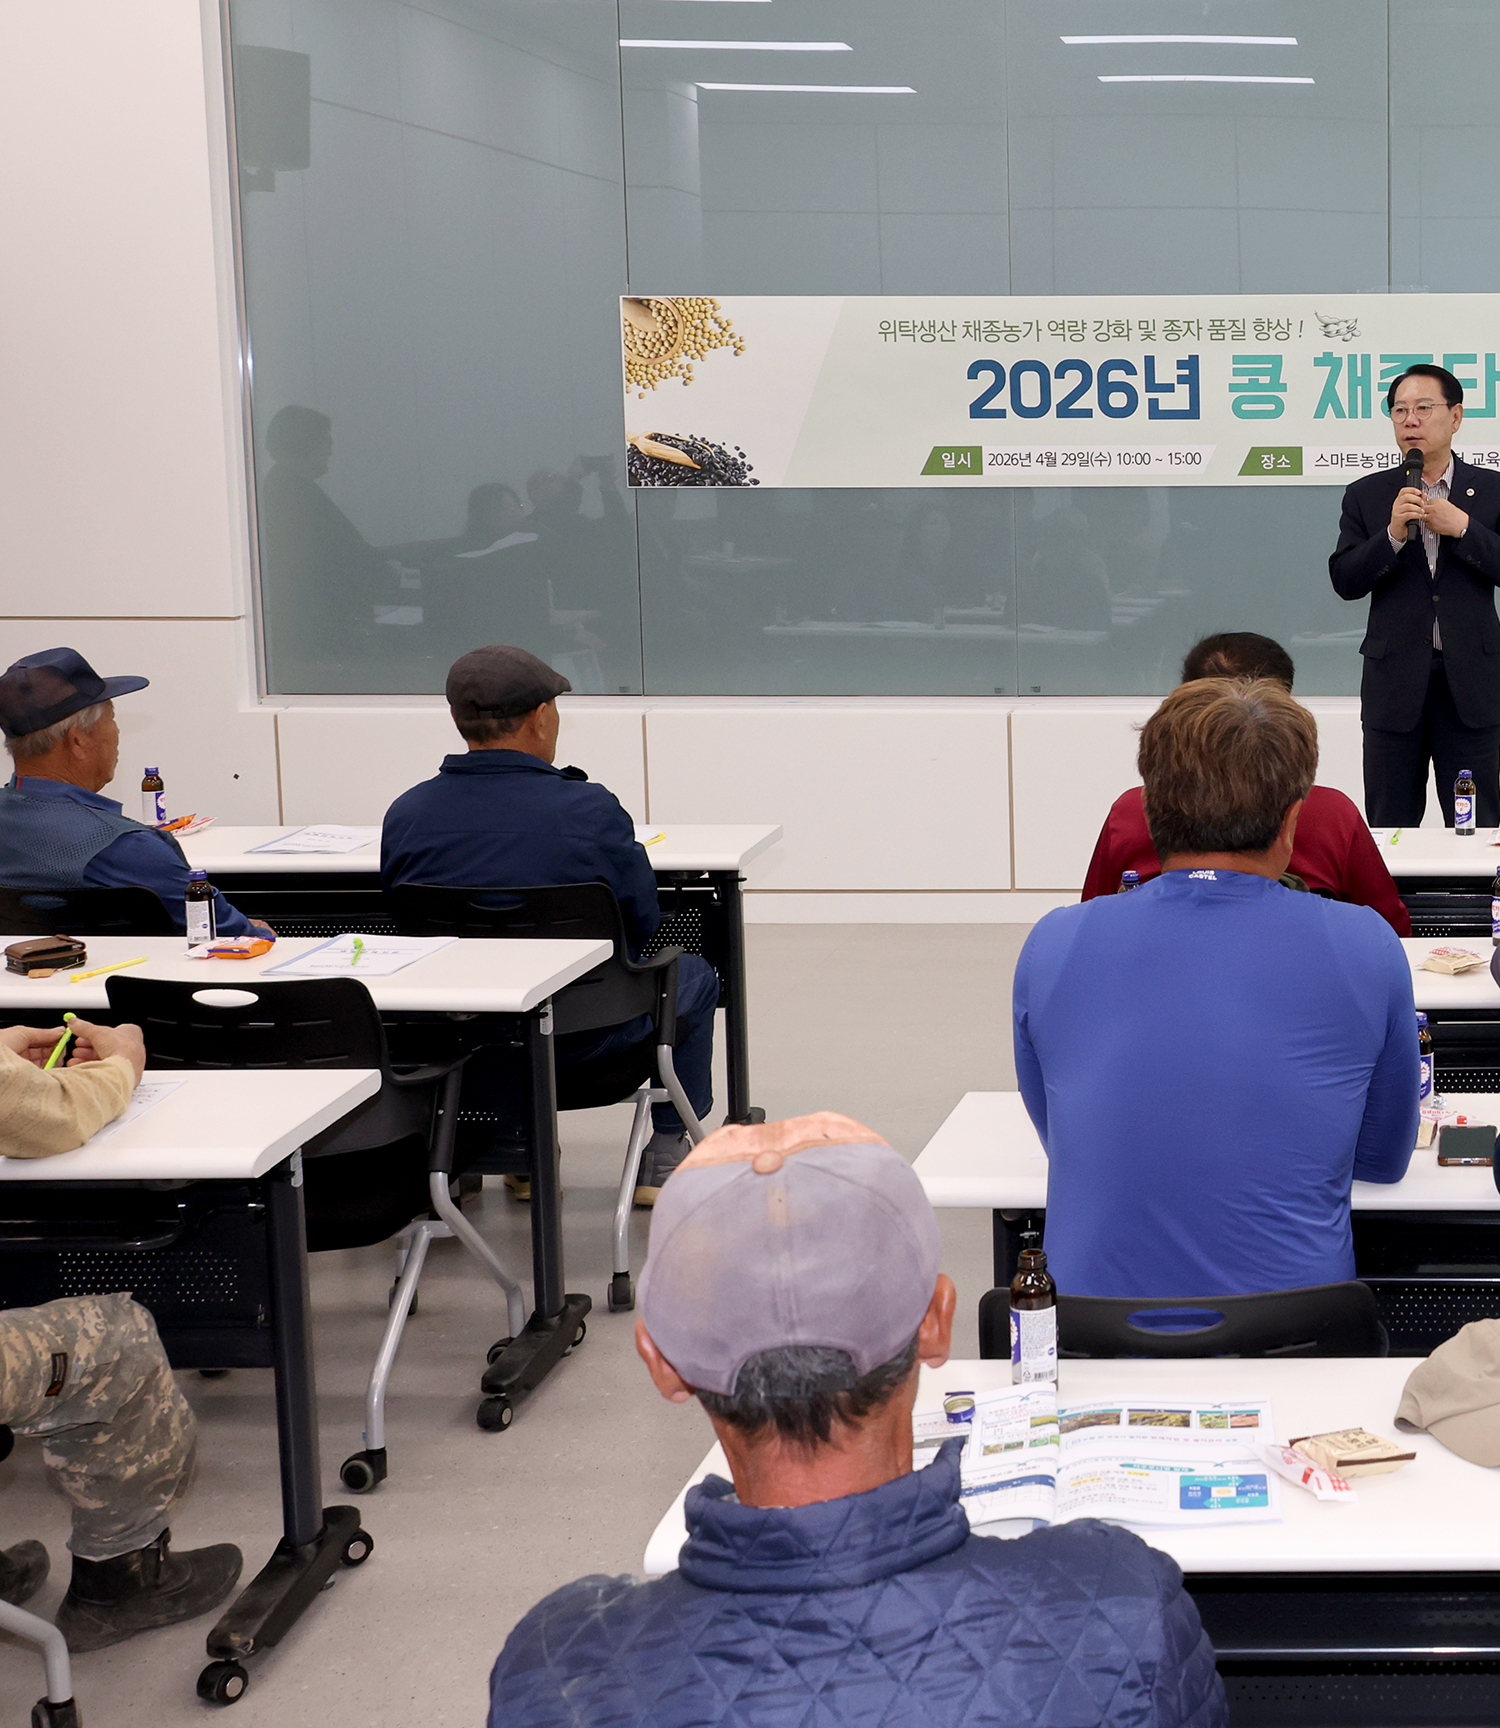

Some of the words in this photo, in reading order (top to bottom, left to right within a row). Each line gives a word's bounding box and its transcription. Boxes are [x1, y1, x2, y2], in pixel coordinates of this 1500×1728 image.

[878, 319, 957, 343] 위탁생산
[962, 319, 1042, 343] 채종농가
[1047, 319, 1087, 343] 역량
[1092, 318, 1132, 342] 강화
[1138, 318, 1157, 342] 및
[1162, 318, 1203, 342] 종자
[1207, 318, 1246, 341] 품질
[1252, 317, 1292, 341] 향상
[966, 354, 1201, 420] 2026년
[1228, 354, 1288, 420] 콩
[941, 451, 972, 468] 일시
[988, 451, 1032, 467] 2026년
[1036, 451, 1057, 467] 4월
[1061, 451, 1112, 468] 29일(수)
[1117, 451, 1151, 466] 10:00
[1168, 451, 1202, 466] 15:00
[1260, 453, 1291, 470] 장소
